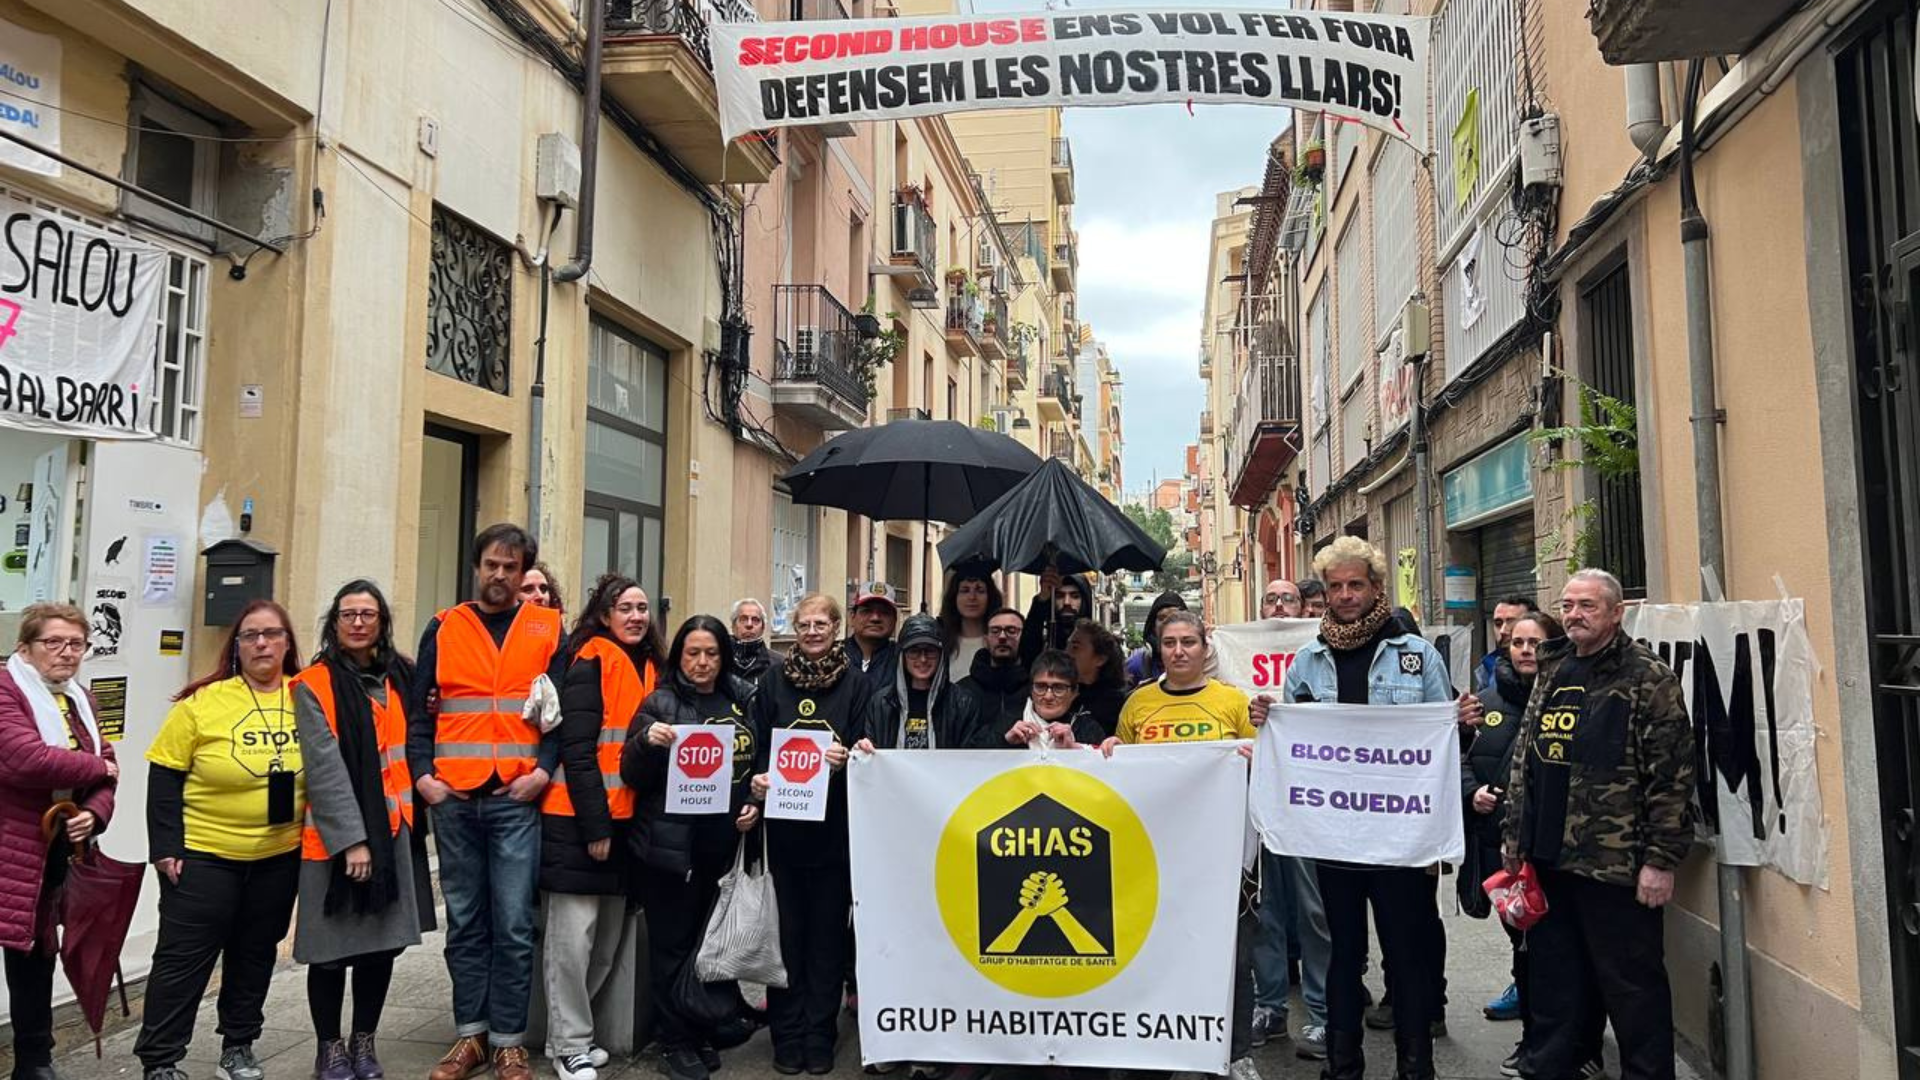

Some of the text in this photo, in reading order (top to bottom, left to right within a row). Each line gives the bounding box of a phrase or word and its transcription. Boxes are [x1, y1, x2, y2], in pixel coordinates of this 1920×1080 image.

[738, 12, 1414, 67] SECOND HOUSE ENS VOL FER FORA
[0, 63, 39, 89] ALOU
[759, 50, 1401, 120] DEFENSEM LES NOSTRES LLARS!
[0, 102, 39, 128] EDA!
[2, 213, 137, 317] SALOU
[96, 589, 126, 599] SECOND
[1252, 653, 1296, 686] ST
[1143, 722, 1213, 740] STOP
[1540, 712, 1576, 731] STO
[679, 746, 721, 765] STOP
[779, 750, 819, 770] STOP
[1291, 743, 1432, 766] BLOC SALOU
[678, 784, 717, 793] SECOND
[777, 788, 814, 798] SECOND
[681, 797, 712, 805] HOUSE
[779, 801, 809, 812] HOUSE
[1290, 786, 1431, 815] ES QUEDA!
[990, 827, 1093, 857] GHAS
[979, 957, 1117, 967] GRUP D'HABITATGE DE SANTS
[876, 1007, 957, 1033] GRUP
[967, 1009, 1127, 1038] HABITATGE
